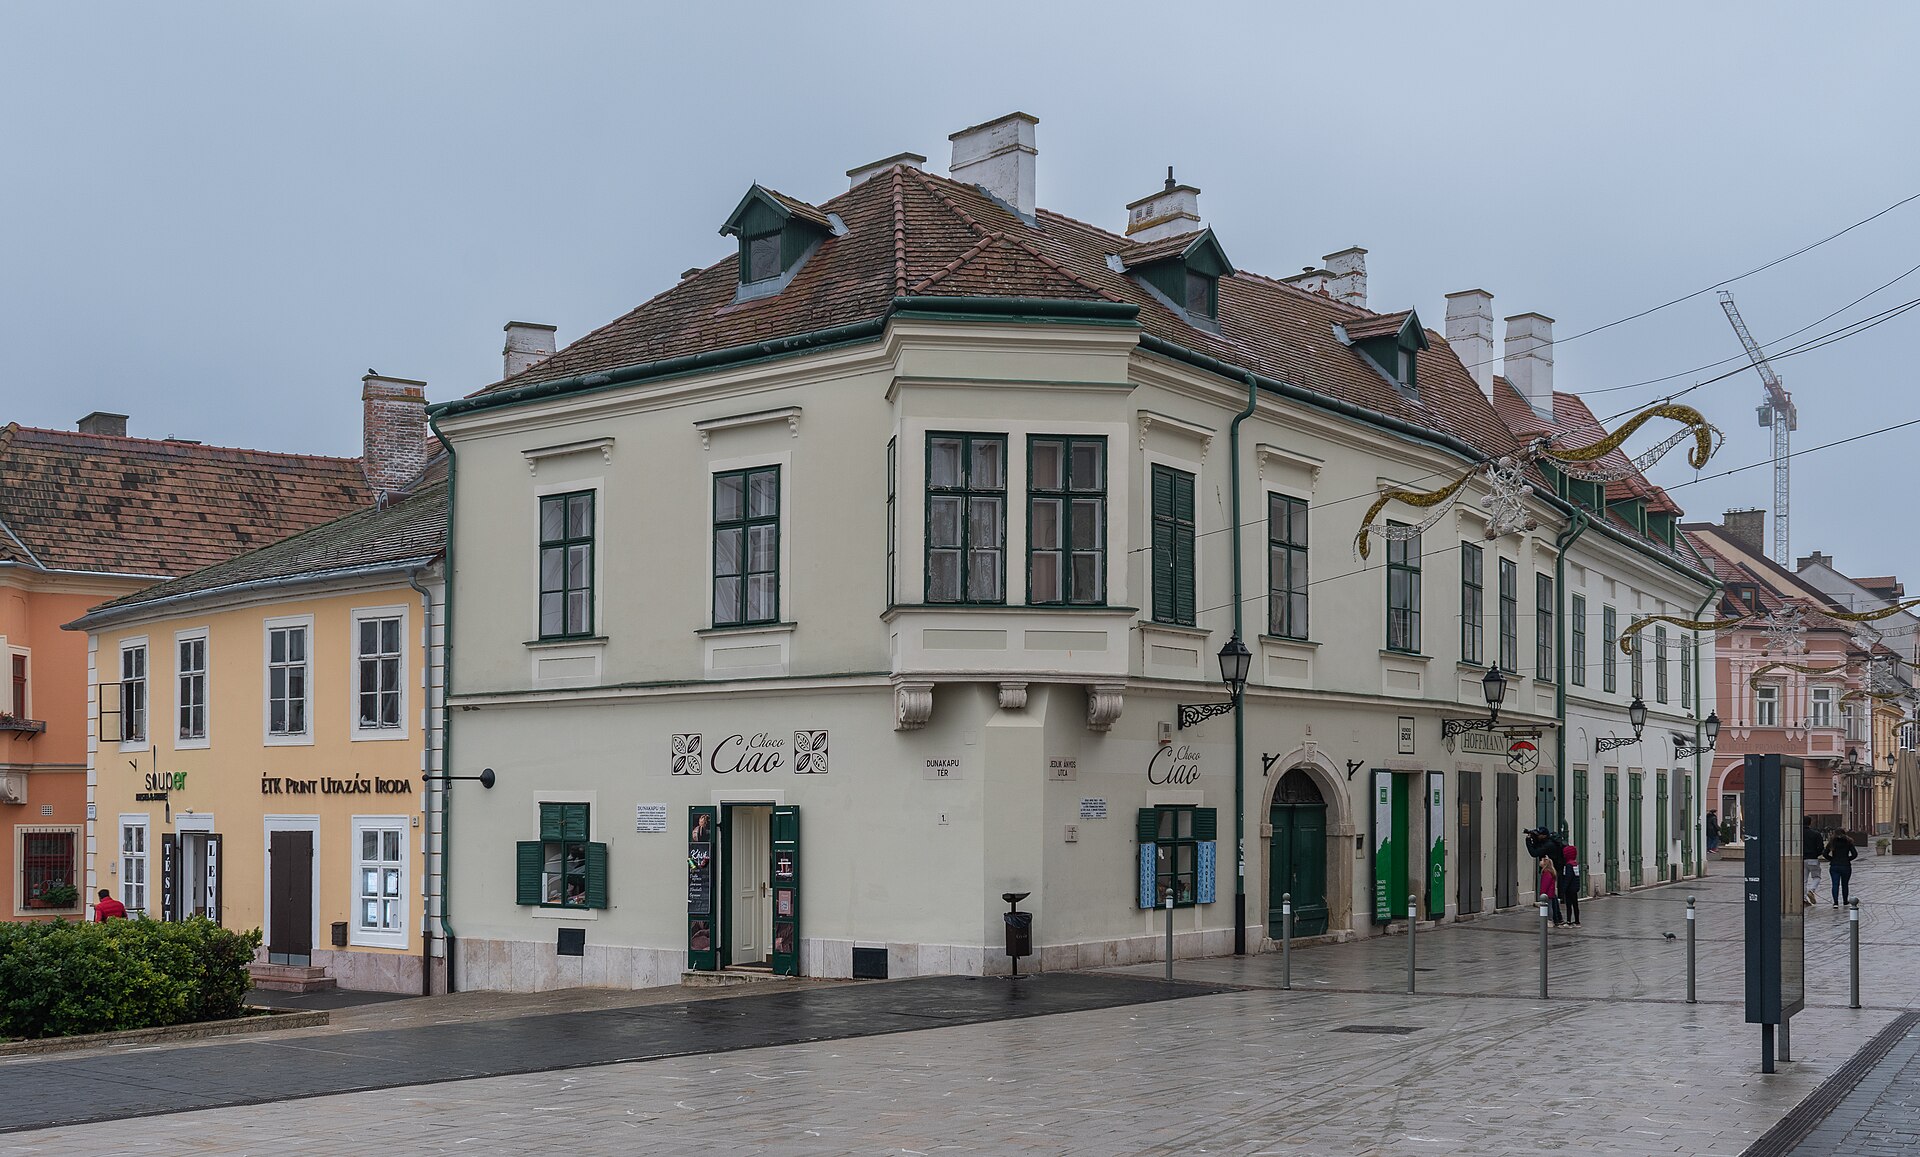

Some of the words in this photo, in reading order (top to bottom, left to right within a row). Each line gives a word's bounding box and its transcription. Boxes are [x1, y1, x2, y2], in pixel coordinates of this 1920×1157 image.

[749, 732, 786, 749] Choco
[1401, 732, 1412, 741] BOX
[1463, 732, 1505, 752] HOFFMANN
[710, 734, 785, 774] Ciao
[1176, 745, 1201, 761] Choco
[926, 759, 960, 768] DUNAKAPU
[1050, 760, 1063, 768] JEDLIK
[1147, 745, 1201, 785] Ciao
[936, 767, 949, 777] TÉR
[1057, 769, 1068, 777] UTCA
[145, 770, 188, 792] souper
[261, 772, 283, 794] ÉTK
